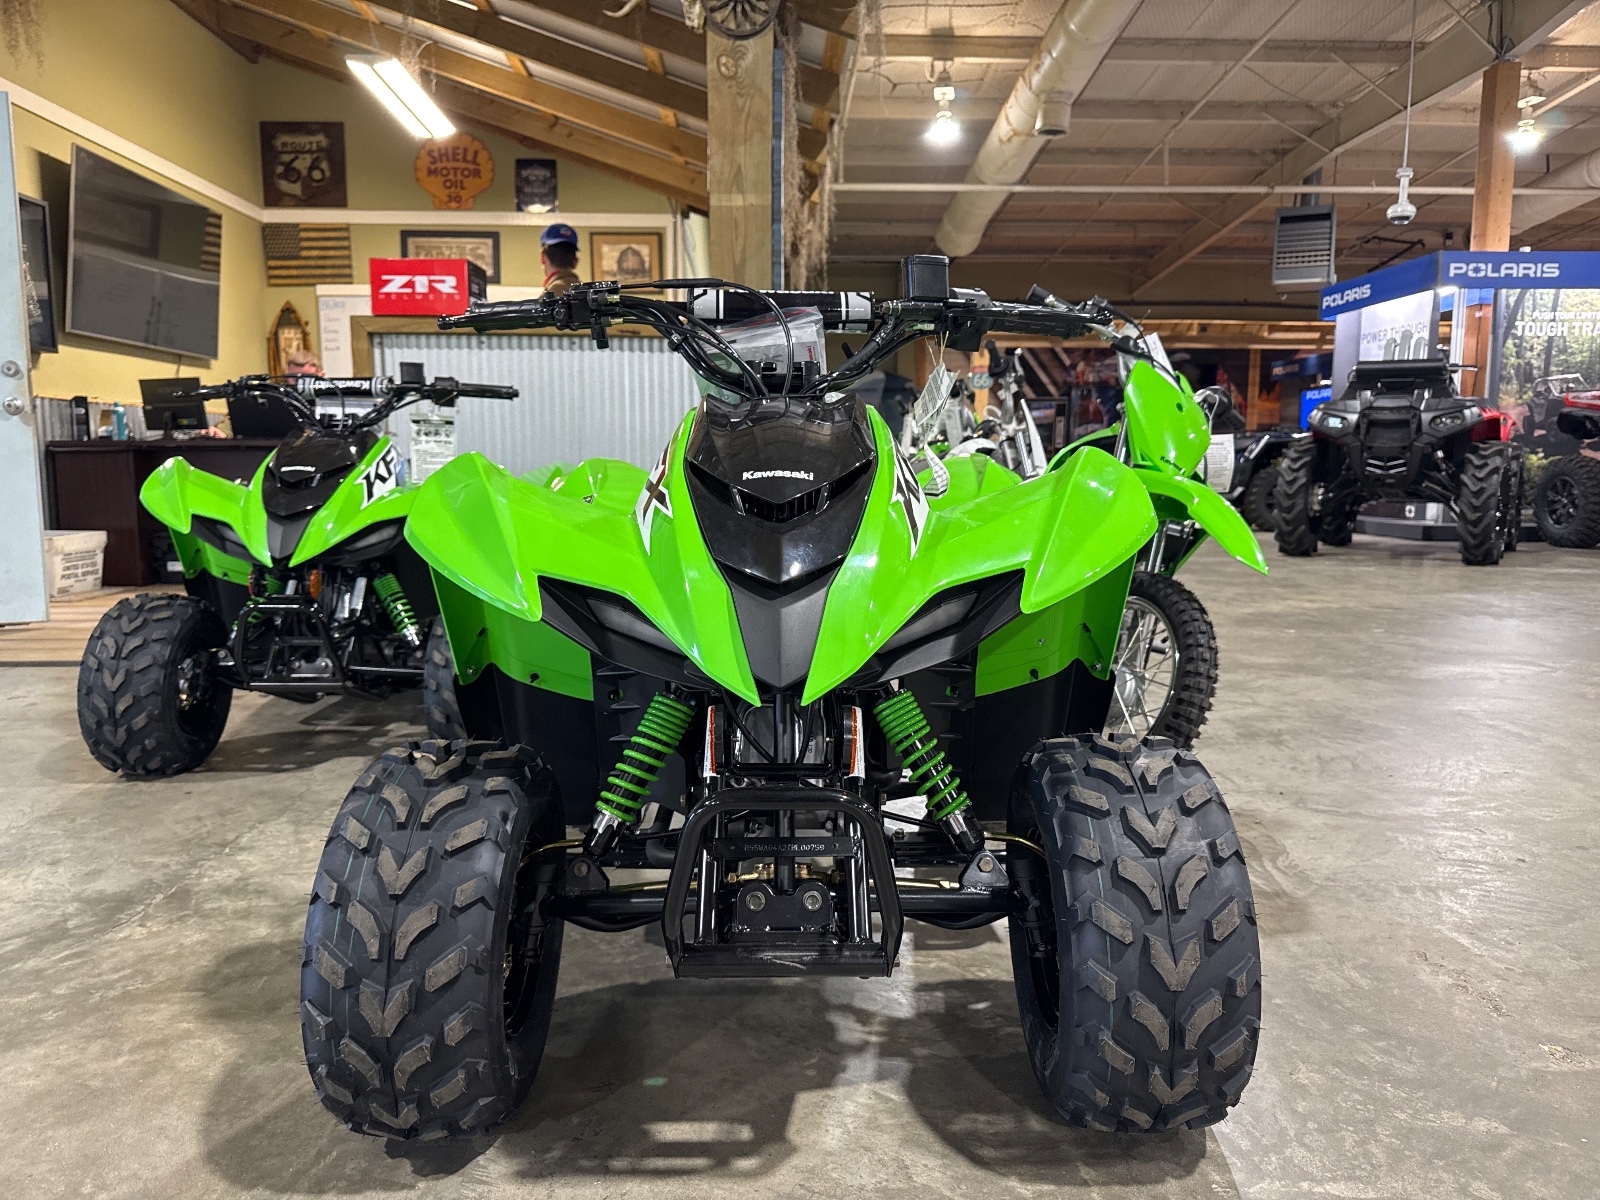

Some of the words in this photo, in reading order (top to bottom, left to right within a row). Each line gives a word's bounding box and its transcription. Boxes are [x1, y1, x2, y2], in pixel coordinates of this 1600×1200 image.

[281, 140, 324, 151] ROUTE
[426, 146, 481, 166] SHELL
[284, 155, 325, 184] 66
[427, 166, 482, 179] MOTOR
[442, 178, 466, 190] OIL
[1448, 262, 1560, 278] POLARIS
[378, 293, 461, 301] HELMETS
[1322, 283, 1372, 310] POLARIS
[1532, 311, 1554, 320] PUSH
[1555, 312, 1576, 320] YOUR
[1361, 328, 1388, 344] POWER
[1514, 321, 1569, 337] TOUGH
[742, 469, 814, 481] Kawasaki
